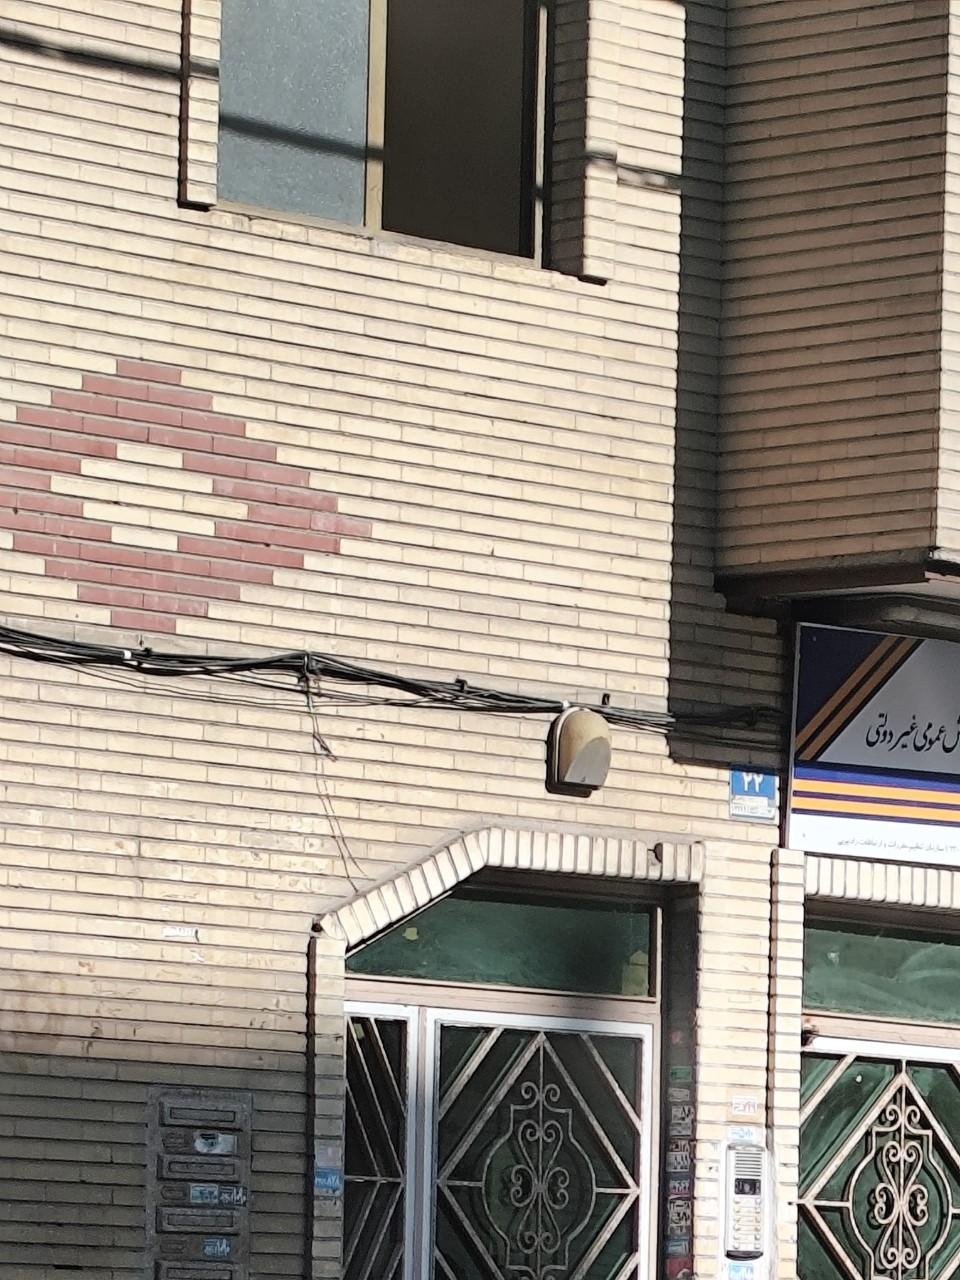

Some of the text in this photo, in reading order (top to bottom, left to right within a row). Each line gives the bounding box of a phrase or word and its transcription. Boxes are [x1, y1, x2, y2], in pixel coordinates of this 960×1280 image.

[865, 712, 894, 748] دولتی
[888, 714, 918, 752] غیر
[913, 722, 945, 752] عمومی
